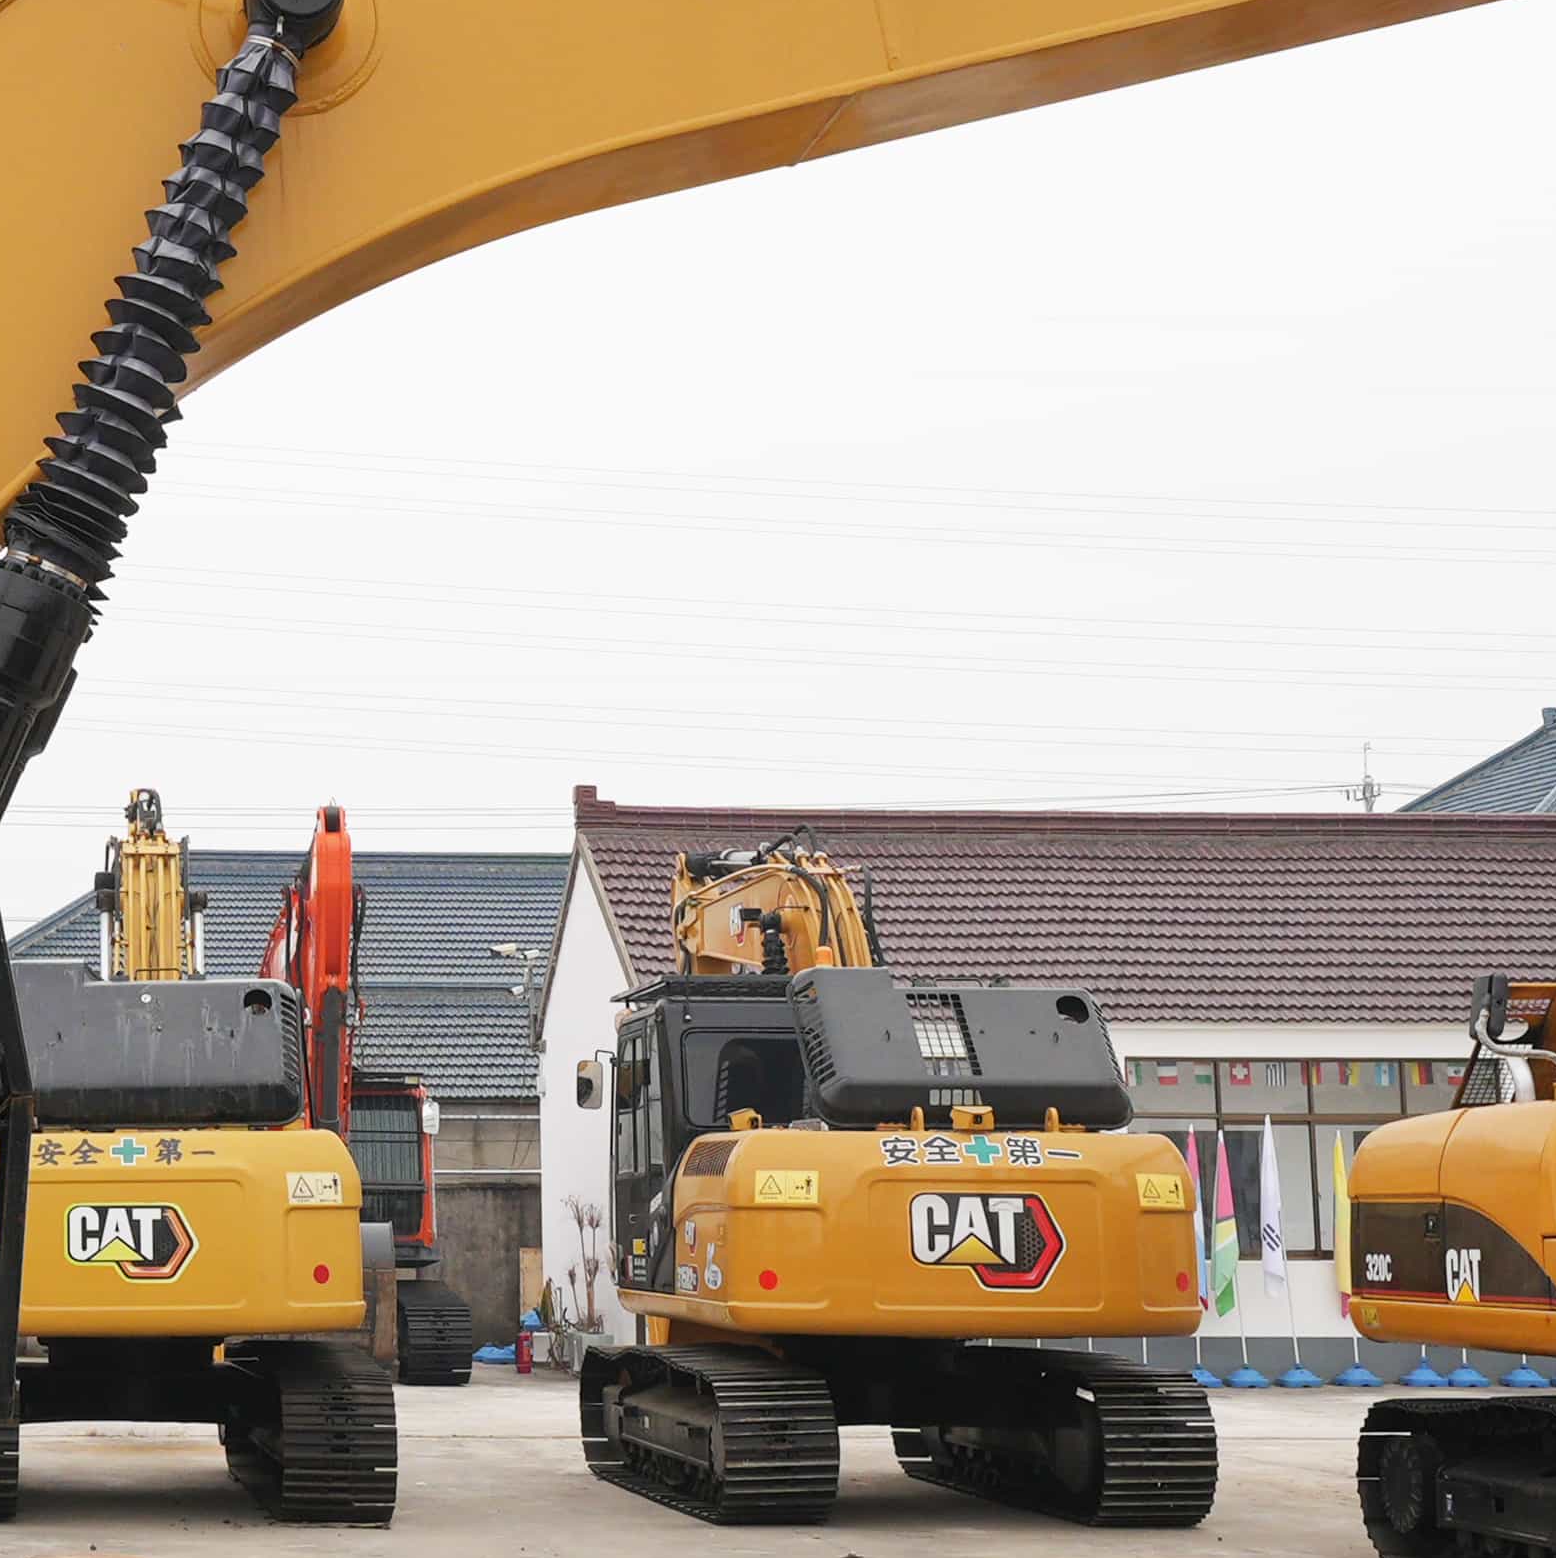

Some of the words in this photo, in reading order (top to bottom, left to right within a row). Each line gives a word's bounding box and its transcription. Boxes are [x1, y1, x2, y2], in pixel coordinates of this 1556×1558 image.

[68, 1205, 162, 1261] CAT
[911, 1193, 1025, 1264] CAT
[1365, 1253, 1392, 1282] 320C
[1445, 1248, 1481, 1302] CAT
